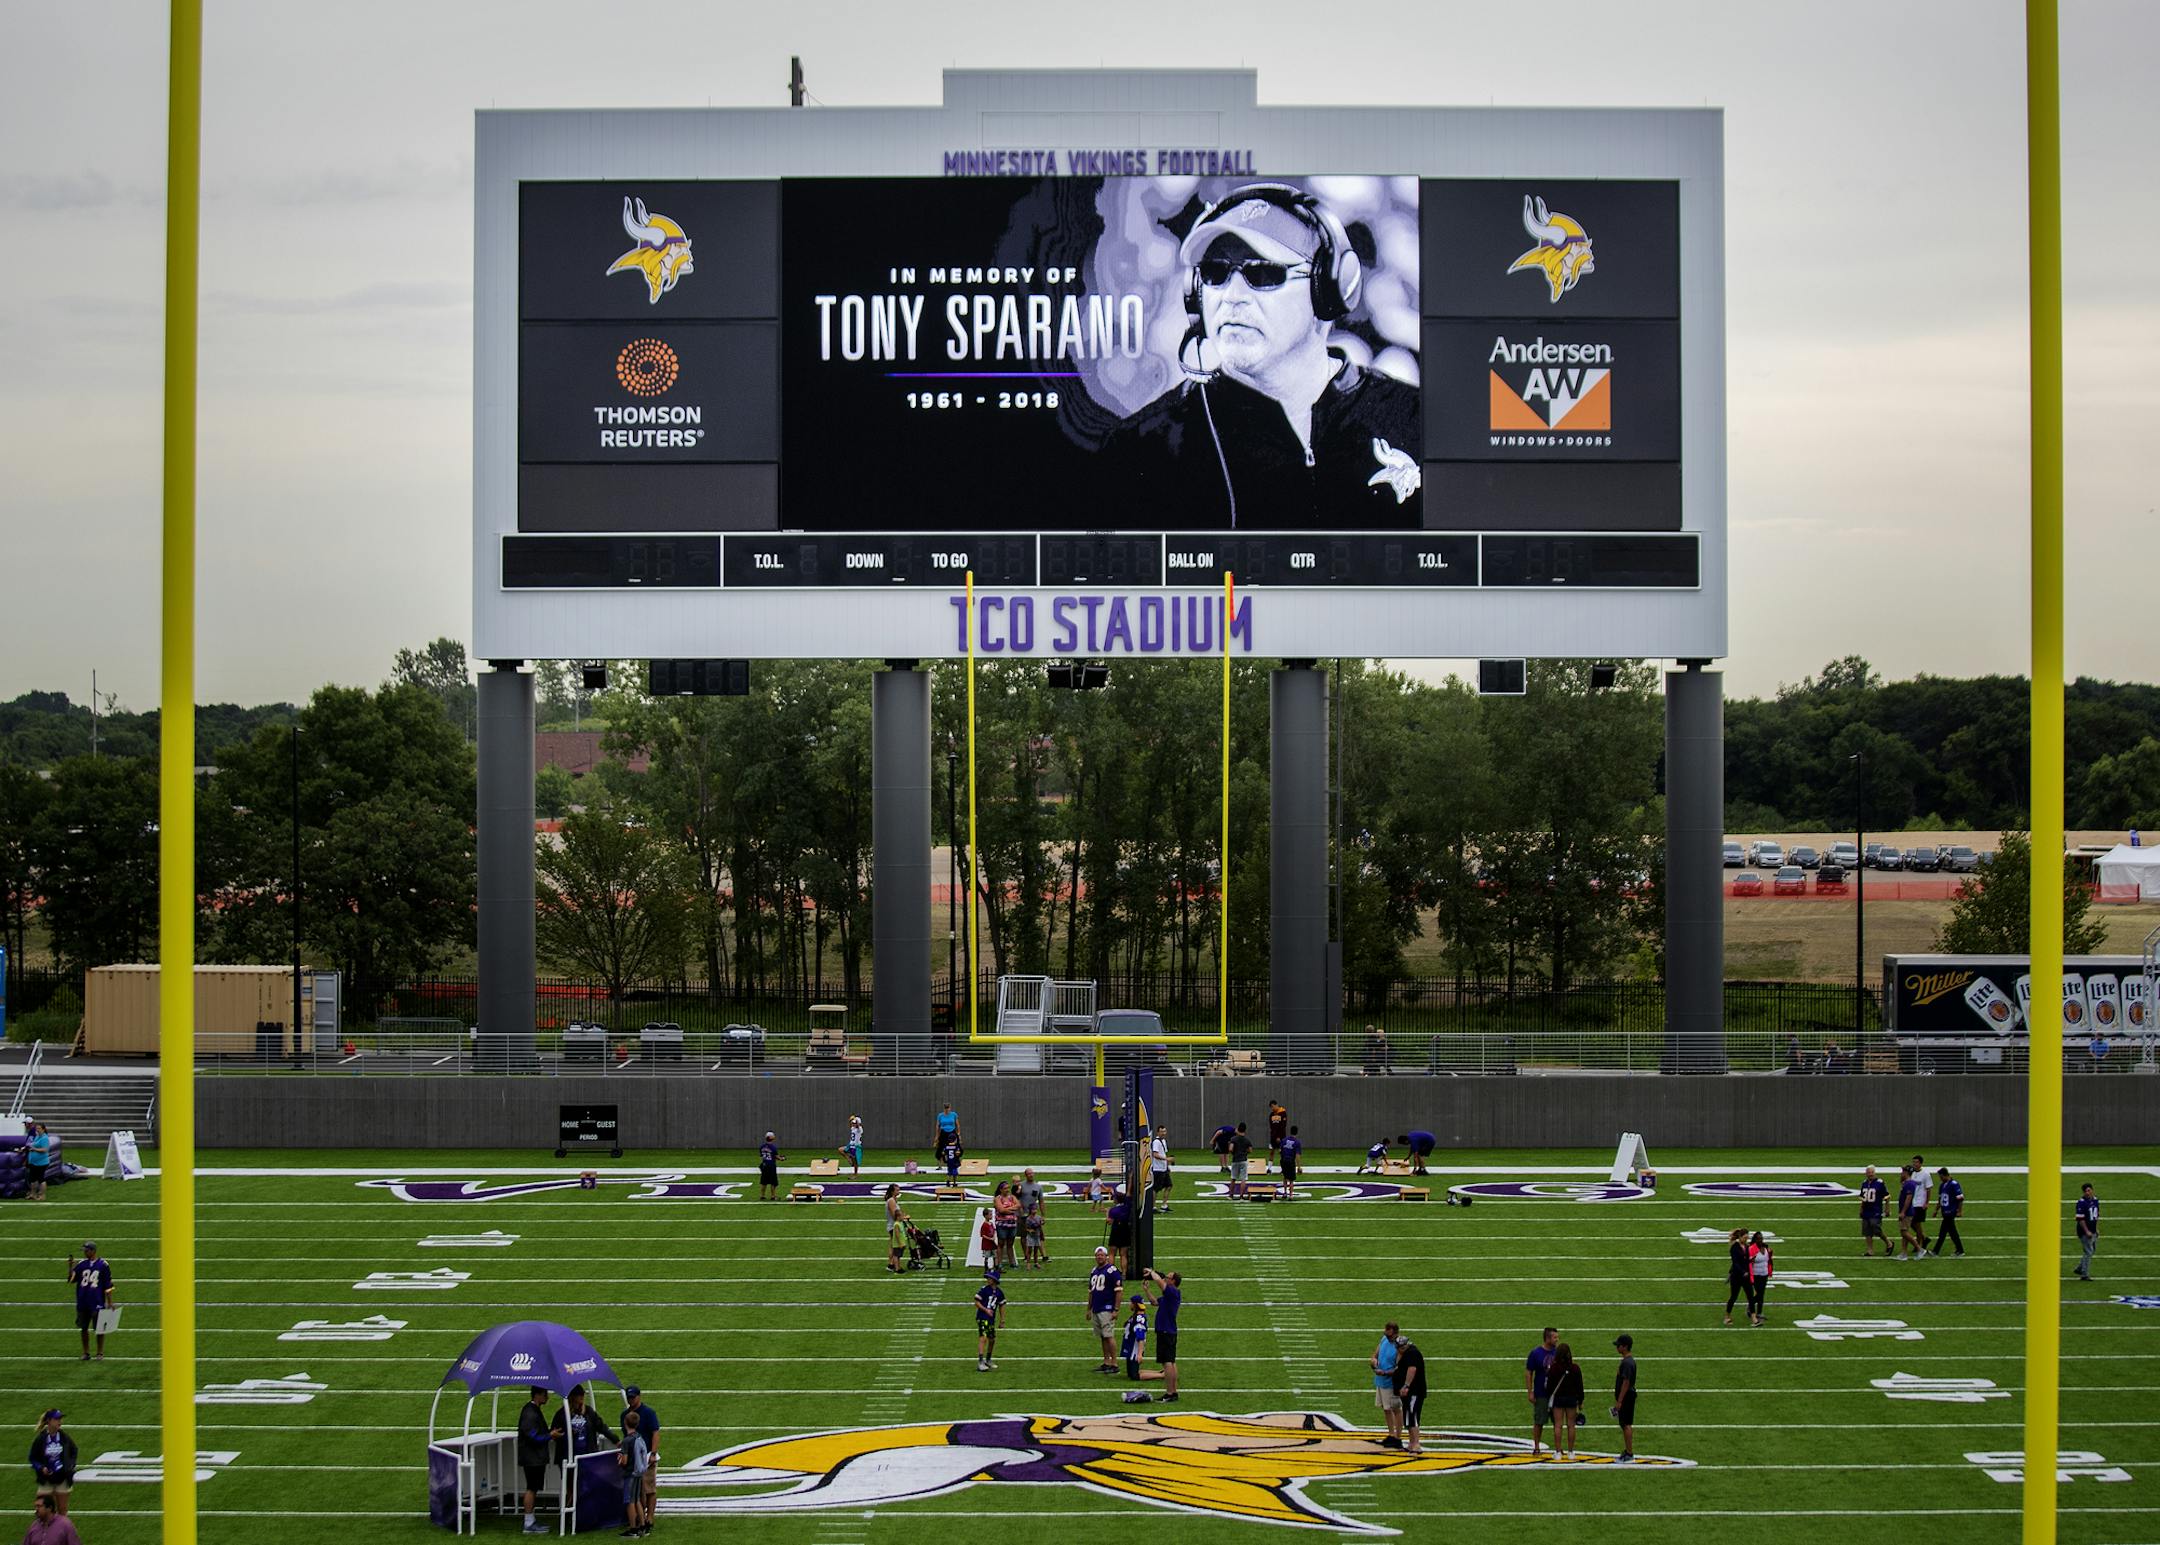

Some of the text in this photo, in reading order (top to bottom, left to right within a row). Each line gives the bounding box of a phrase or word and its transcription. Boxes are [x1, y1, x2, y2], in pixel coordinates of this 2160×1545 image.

[943, 149, 1258, 176] MINNESOTA VIKINGS FOOTBALL
[890, 267, 1077, 283] IN MEMORY OF
[814, 294, 1145, 361] TONY SPARANO
[1488, 335, 1612, 363] Andersen
[907, 392, 963, 408] 1961
[998, 392, 1059, 408] 2018
[594, 406, 701, 424] THOMSON
[753, 553, 784, 569] T.O.L.
[846, 553, 884, 569] DOWN
[931, 553, 969, 569] TO GO
[1168, 553, 1214, 569] BALL ON
[1290, 553, 1316, 569] QTR
[1417, 553, 1448, 569] T.O.L.
[950, 596, 1253, 653] TCO STADIUM
[1905, 970, 1974, 1002] Miller
[2091, 982, 2115, 1000] Lite
[1969, 983, 1995, 1010] Lite
[561, 1120, 580, 1128] HOME
[596, 1120, 616, 1128] GUEST
[1862, 1187, 1877, 1203] 30
[2088, 1206, 2099, 1221] 14
[81, 1268, 100, 1288] 84
[987, 1295, 999, 1310] 14
